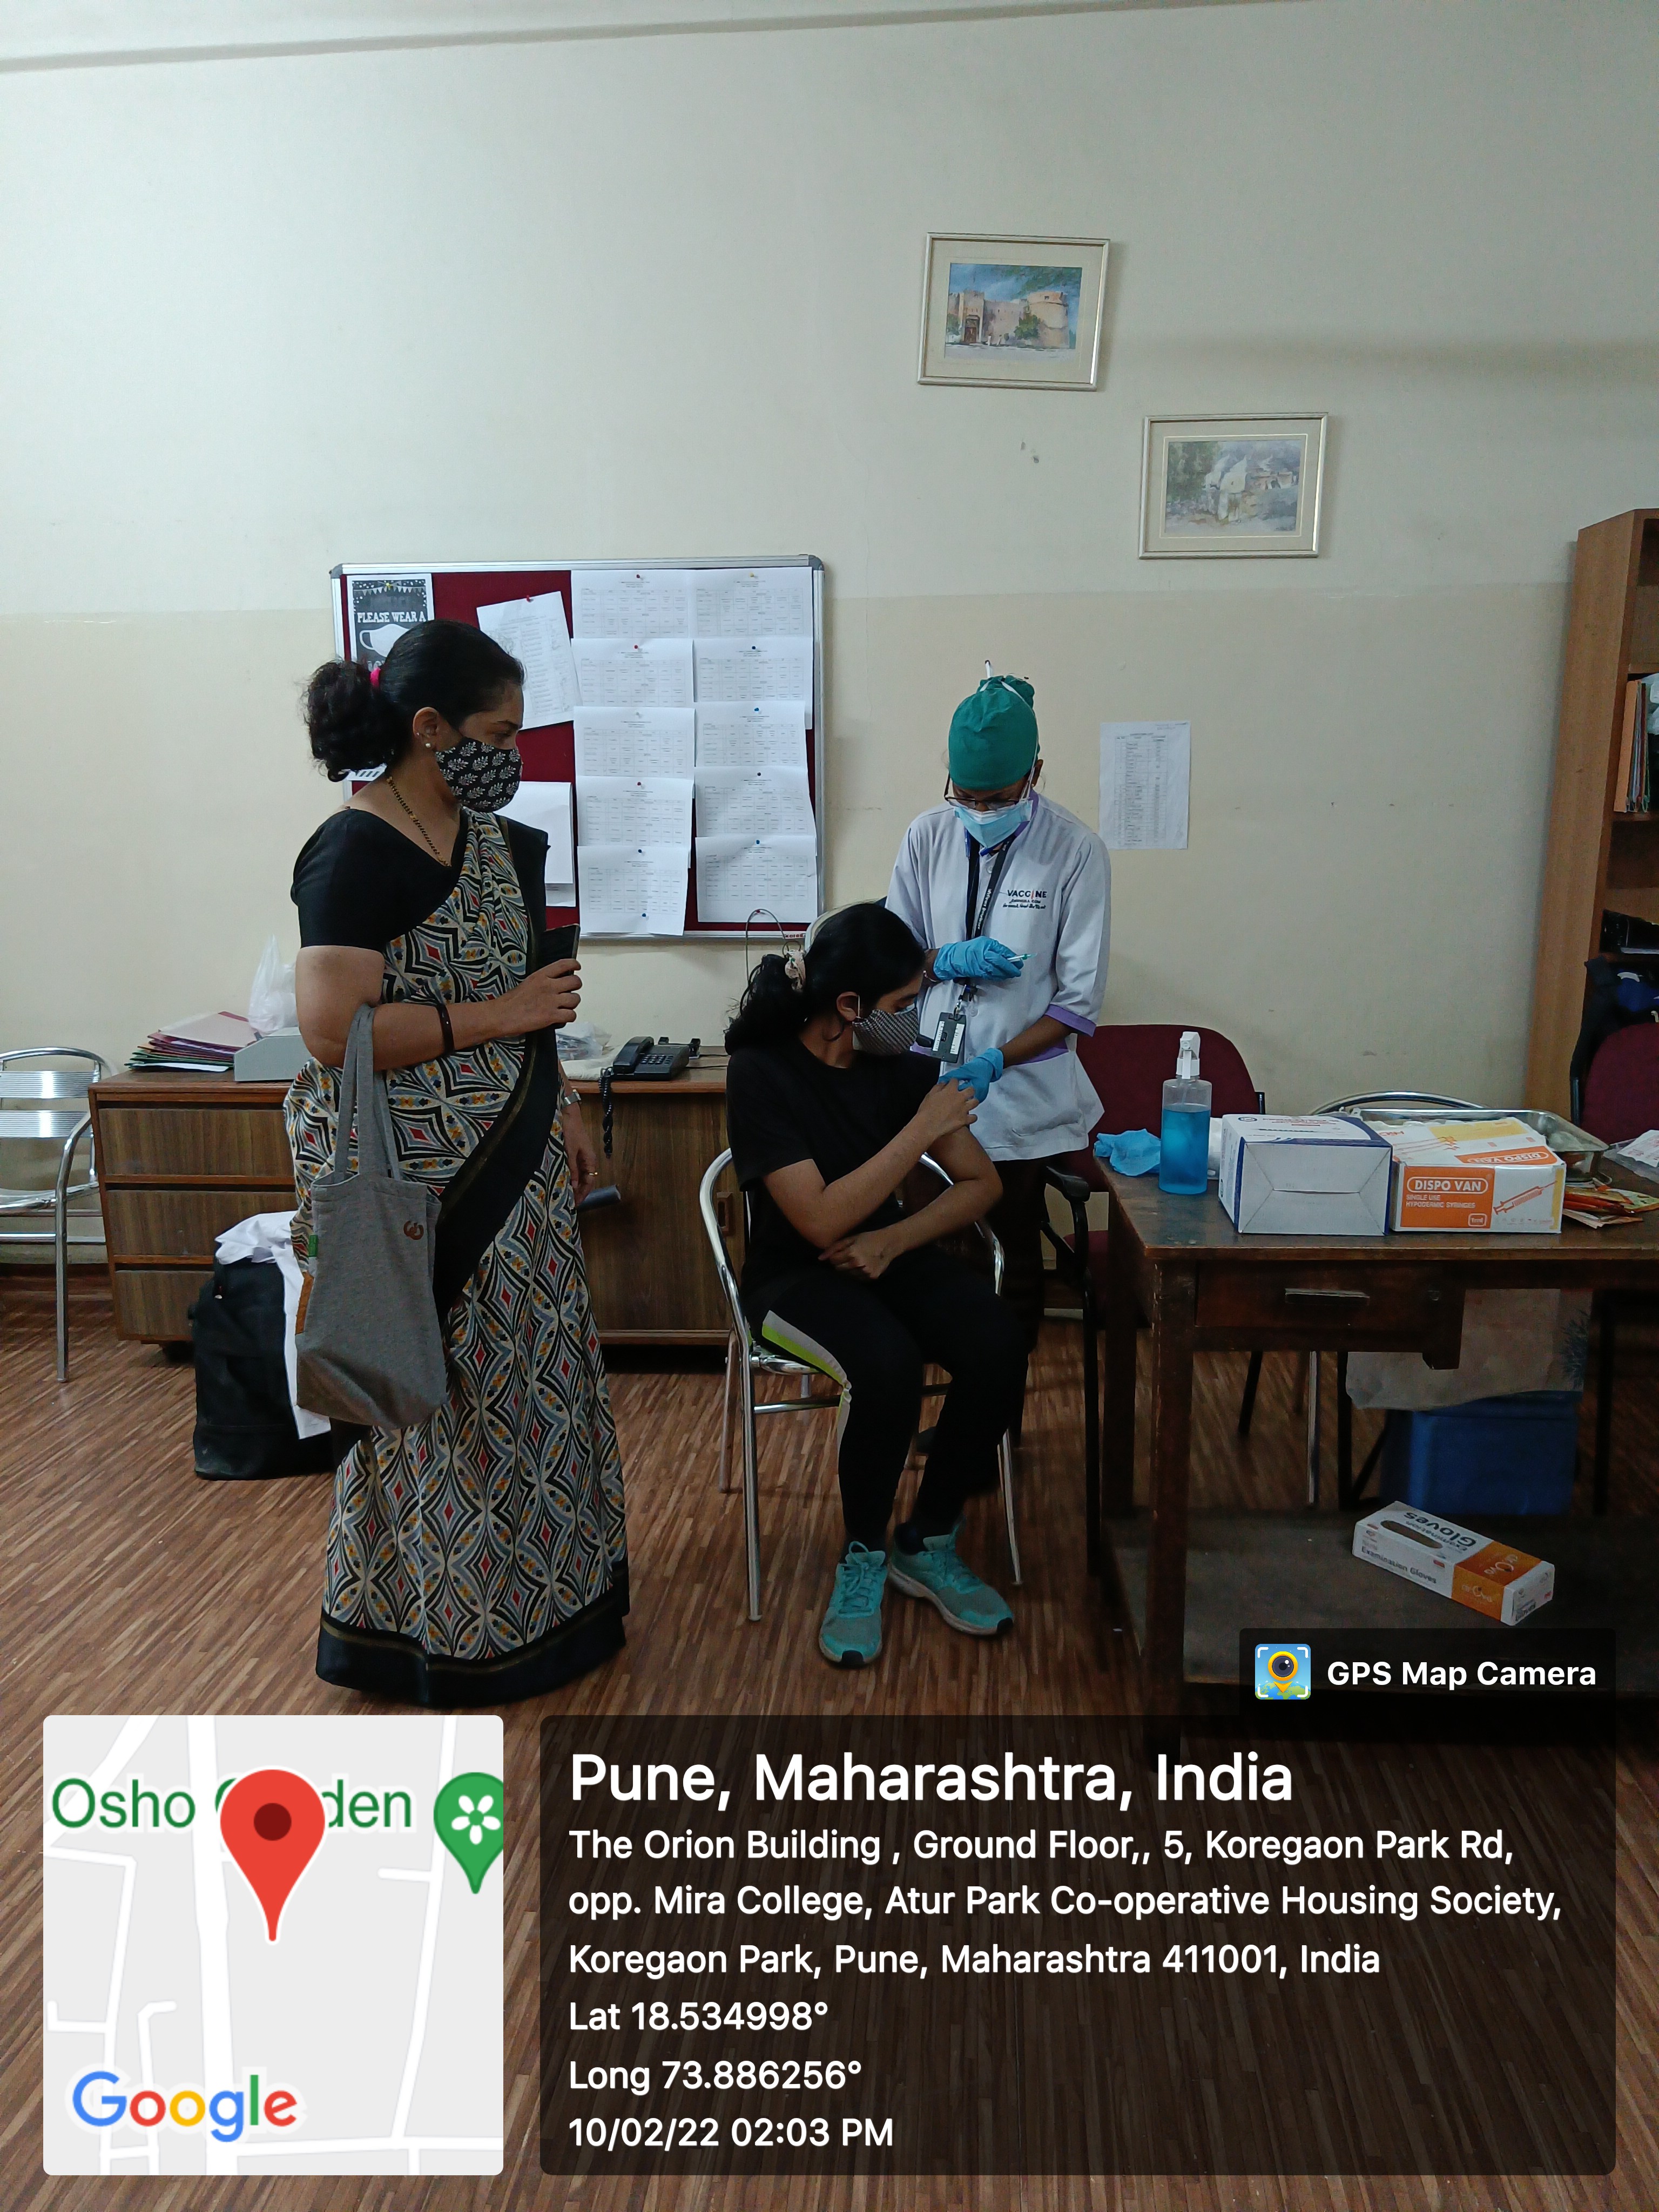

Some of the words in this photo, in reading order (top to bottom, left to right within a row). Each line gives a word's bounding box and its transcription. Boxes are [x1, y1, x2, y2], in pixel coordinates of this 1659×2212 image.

[357, 612, 390, 623] PLEASE
[392, 611, 417, 622] WEAR
[419, 611, 427, 622] A
[1414, 1179, 1451, 1191] DISPO
[1454, 1181, 1482, 1192] VAN
[1404, 1512, 1476, 1547] Gloves
[1361, 1545, 1408, 1572] Examination
[1410, 1566, 1437, 1584] Gloves
